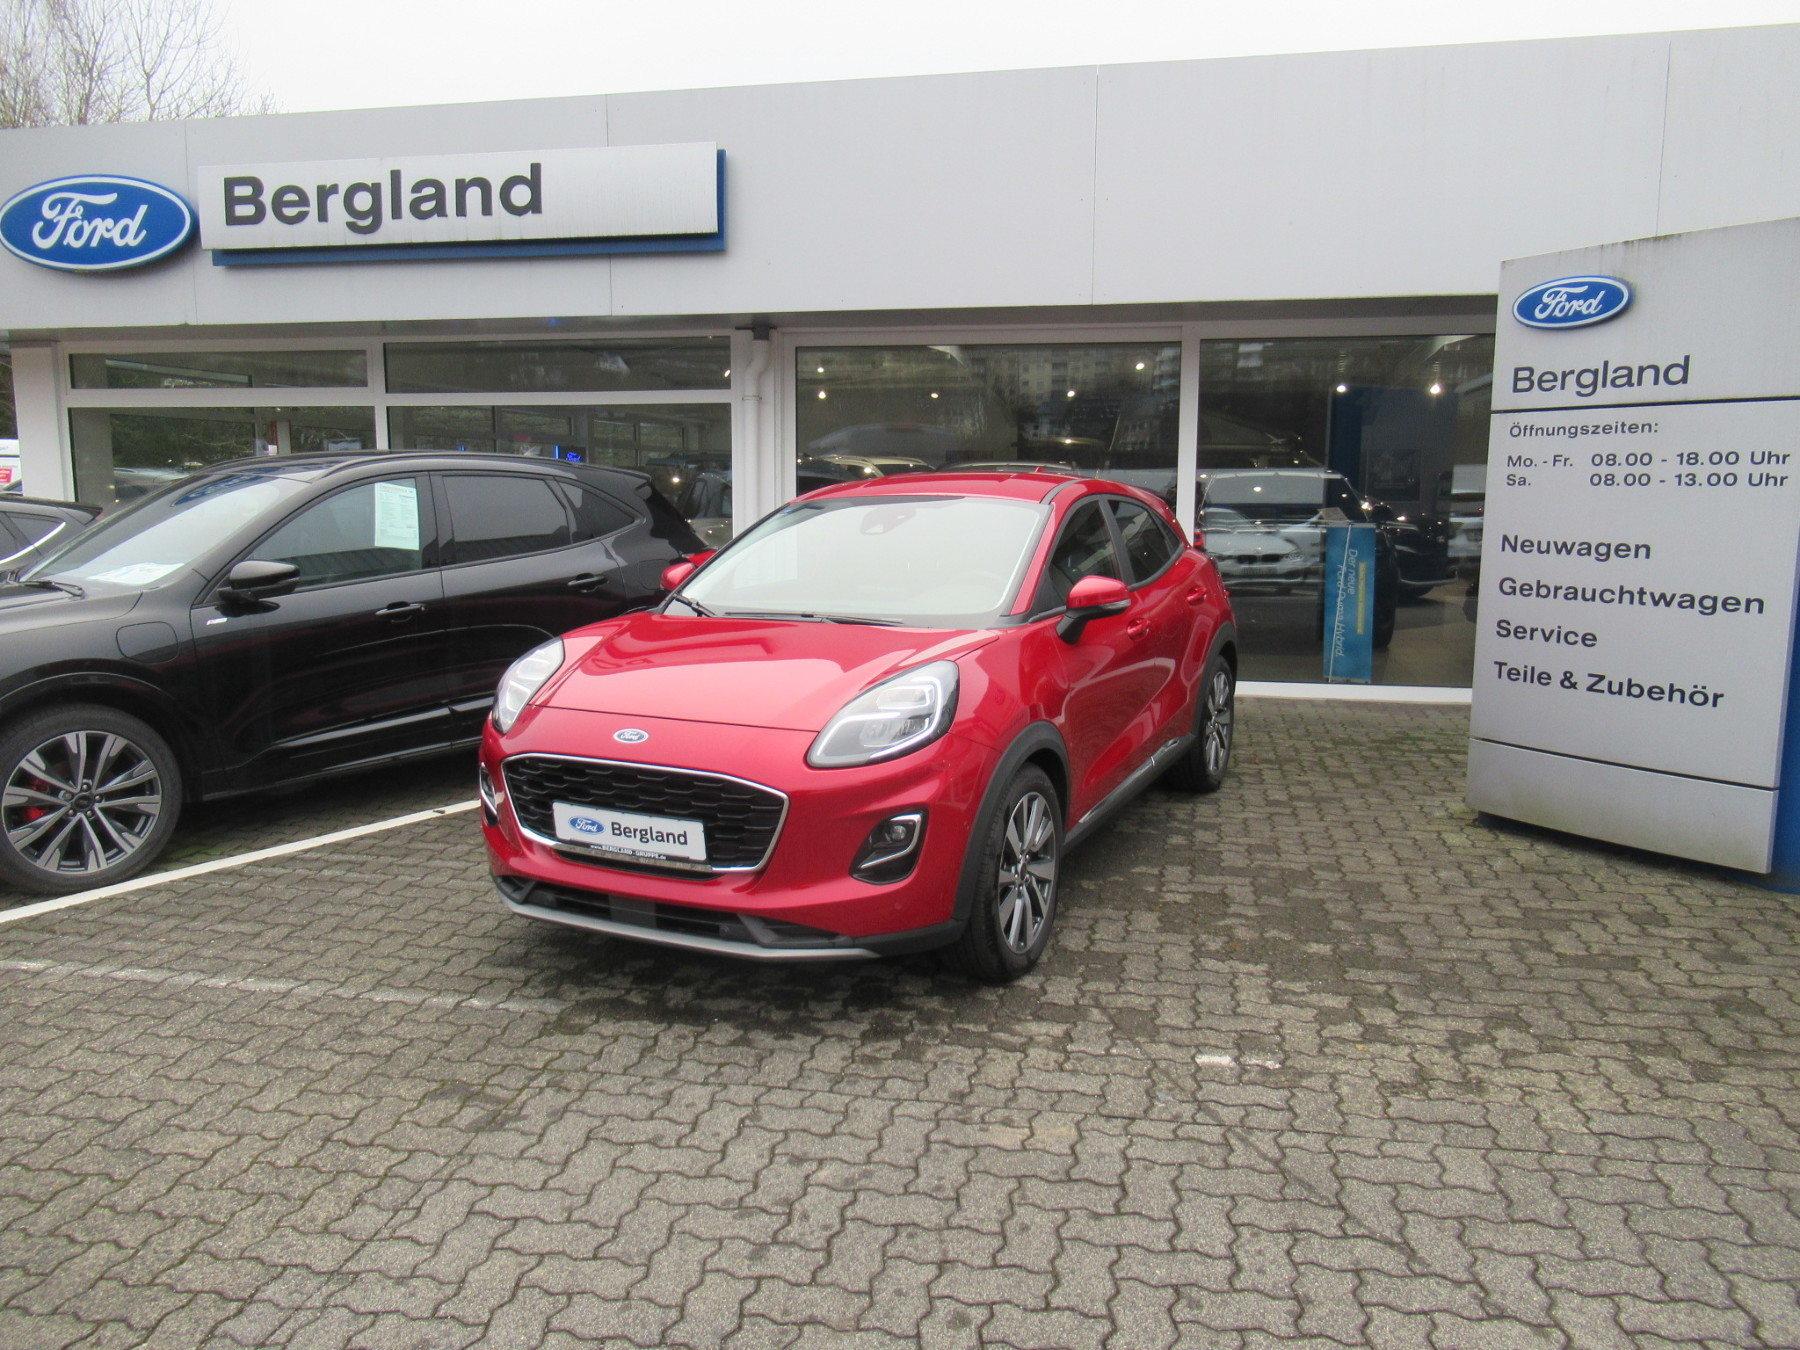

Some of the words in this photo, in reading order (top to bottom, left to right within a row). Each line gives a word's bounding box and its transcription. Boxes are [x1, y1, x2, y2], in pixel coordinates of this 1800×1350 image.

[222, 162, 543, 235] Bergland
[32, 191, 149, 250] Ford
[1534, 284, 1606, 320] Ford
[1511, 354, 1691, 398] Bergland
[1509, 421, 1659, 439] Öffnungszeiten:
[1507, 454, 1538, 468] Mo.
[1552, 454, 1574, 467] Fr.
[1591, 452, 1653, 467] 08.00
[1676, 451, 1740, 466] 18.00
[1750, 450, 1791, 465] Uhr
[1506, 473, 1532, 487] Sa.
[1589, 472, 1652, 487] 08.00
[1674, 472, 1738, 487] 13.00
[1748, 472, 1789, 487] Uhr
[1500, 534, 1652, 562] Neuwagen
[1498, 576, 1765, 616] Gebrauchtwagen
[1495, 618, 1598, 648] Service
[1493, 661, 1552, 687] Teile
[1559, 671, 1578, 690] &
[1586, 673, 1725, 708] Zubehör
[576, 818, 598, 833] Ford
[611, 821, 688, 846] Bergland
